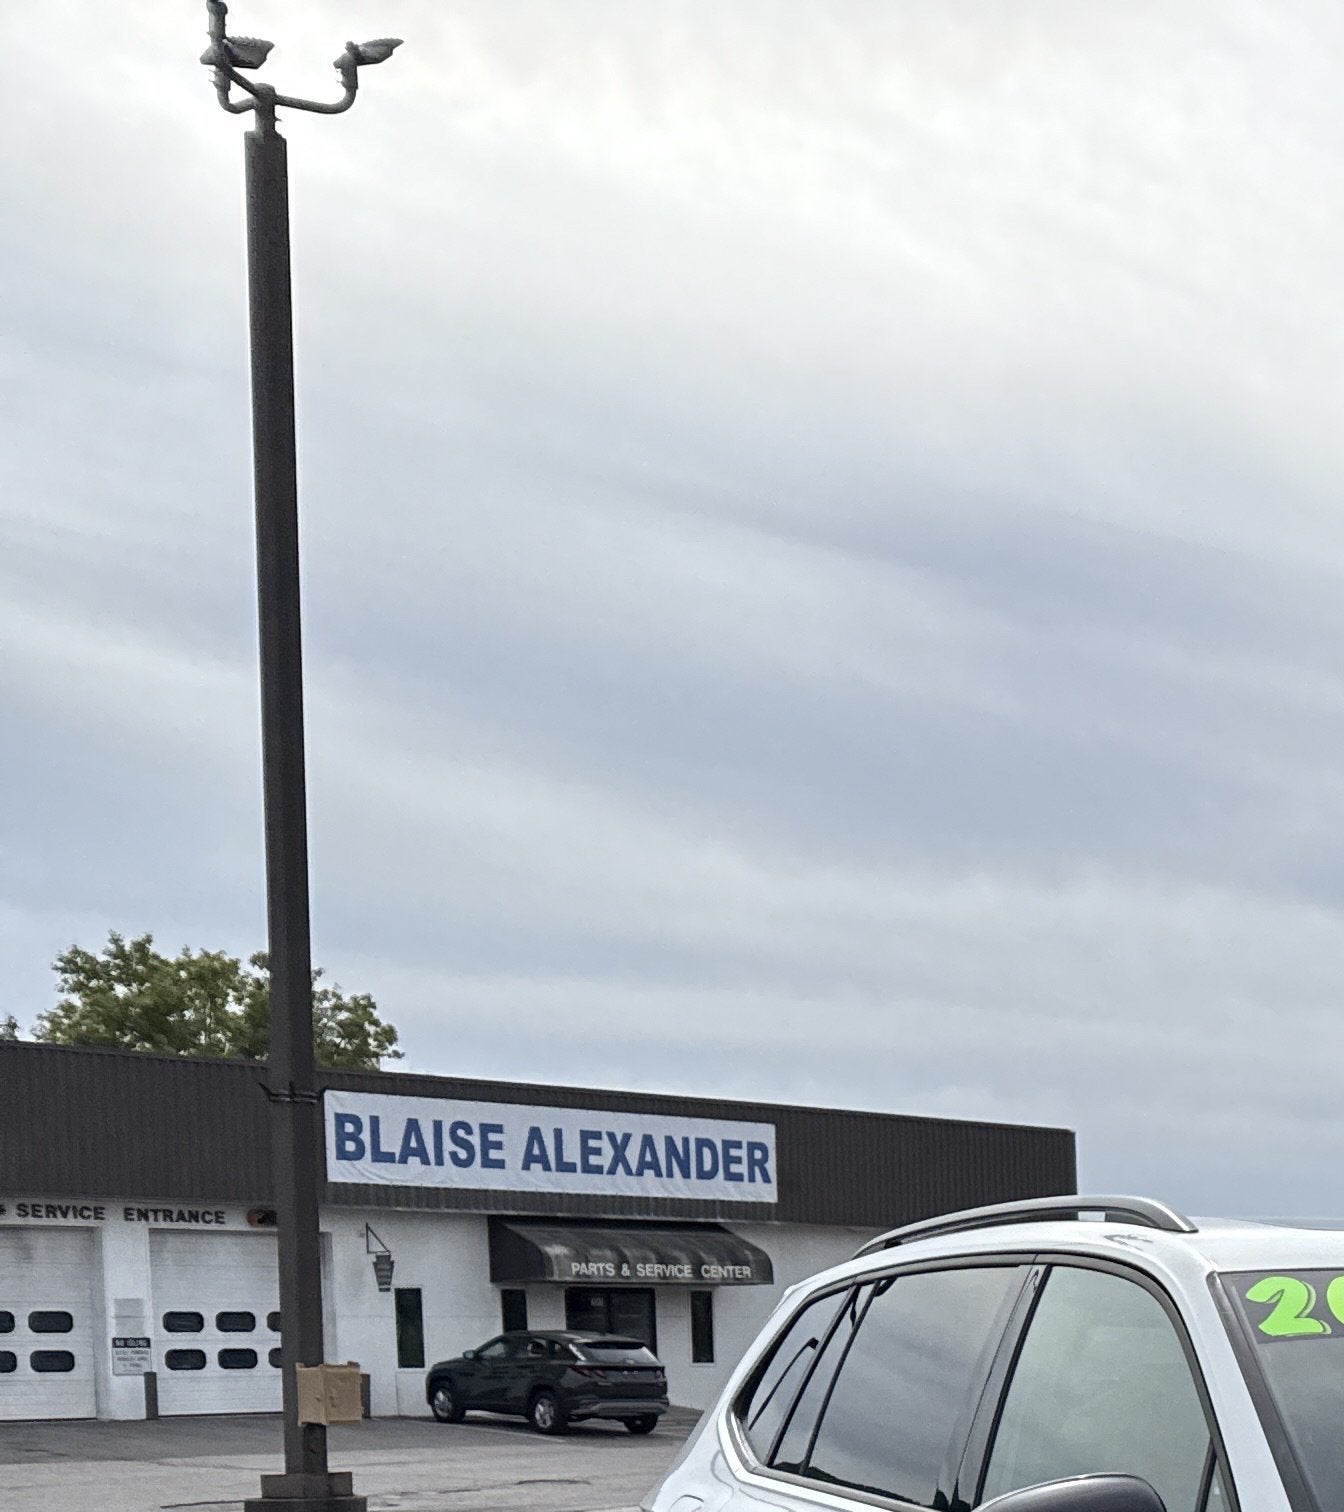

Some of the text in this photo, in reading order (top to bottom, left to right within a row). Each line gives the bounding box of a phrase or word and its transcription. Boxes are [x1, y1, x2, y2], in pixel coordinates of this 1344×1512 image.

[333, 1112, 771, 1183] BLAISE ALEXANDER
[16, 1203, 225, 1225] SERVICE ENTRANCE
[570, 1262, 751, 1279] PARTS & SERVICE CENTER
